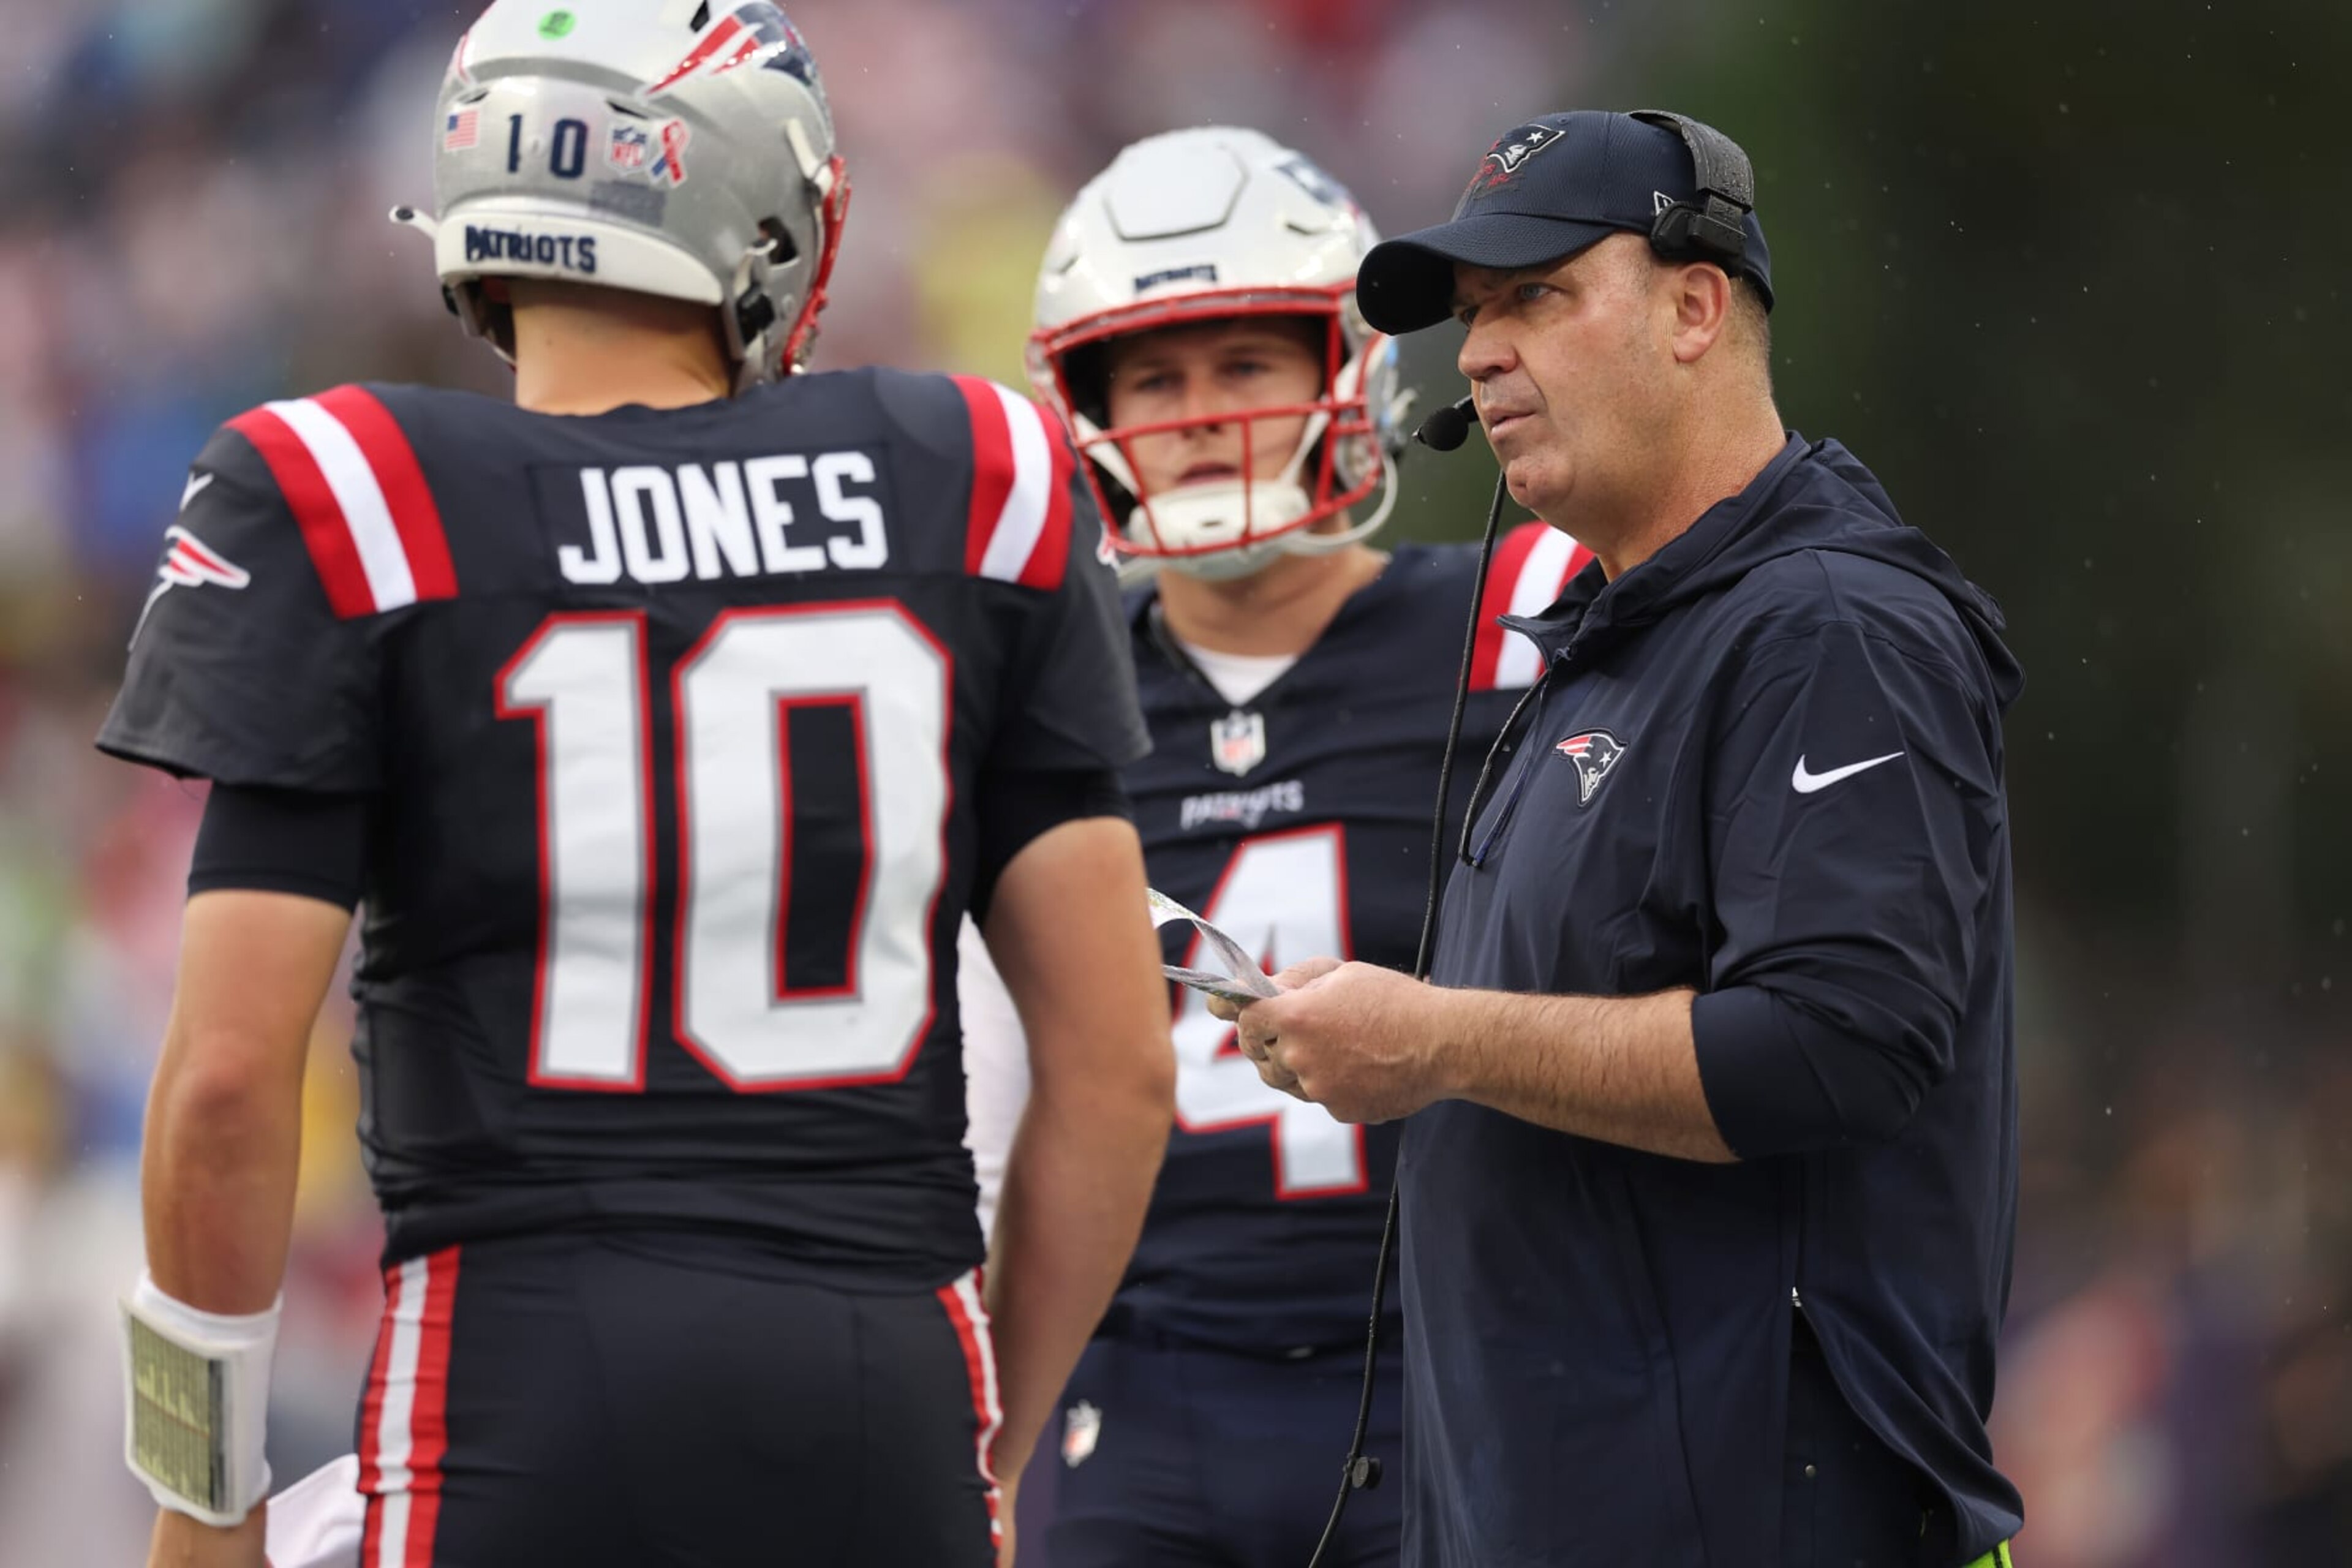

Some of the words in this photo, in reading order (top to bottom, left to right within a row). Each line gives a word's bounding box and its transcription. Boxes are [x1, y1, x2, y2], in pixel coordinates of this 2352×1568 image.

[508, 114, 589, 178] 10
[466, 225, 595, 273] PATRIOTS
[559, 452, 888, 584] JONES
[494, 598, 954, 1092] 10
[1172, 823, 1368, 1200] 4
